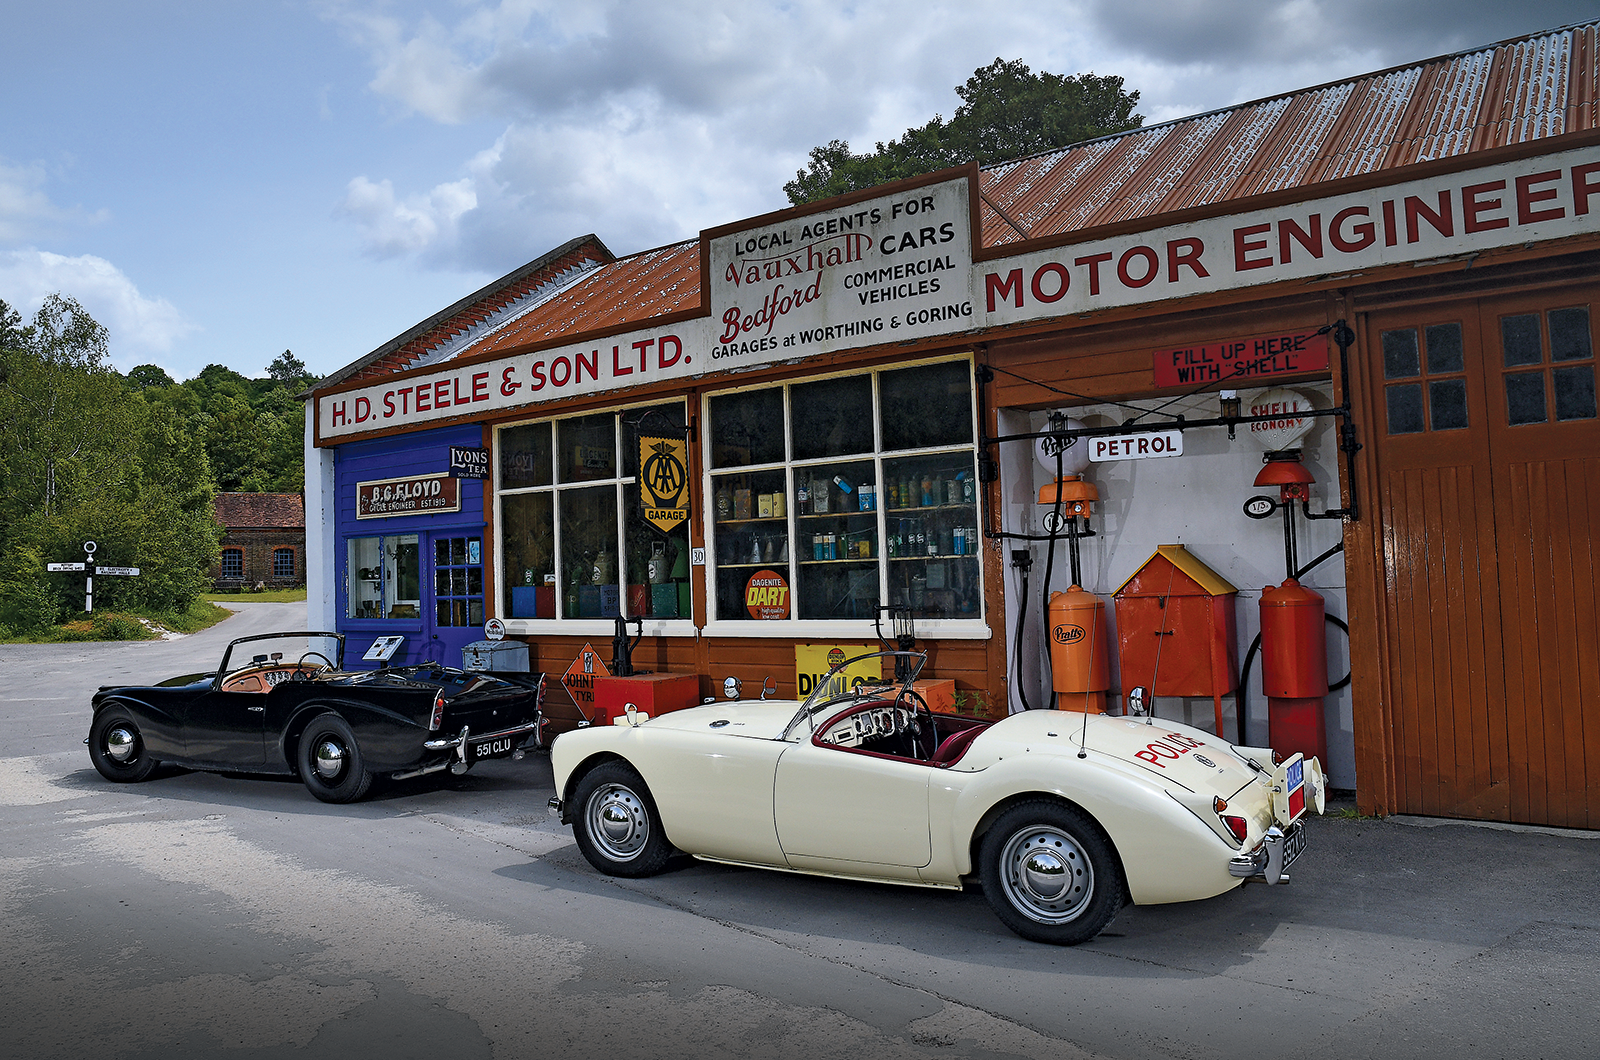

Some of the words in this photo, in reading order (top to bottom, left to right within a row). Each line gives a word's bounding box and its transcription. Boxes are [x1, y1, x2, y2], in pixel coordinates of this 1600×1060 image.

[735, 230, 793, 257] LOCAL
[800, 208, 882, 241] AGENTS
[891, 195, 936, 220] FOR
[725, 232, 874, 289] Vauxhall
[879, 222, 956, 256] CARS
[843, 254, 957, 290] COMMERCIAL
[983, 236, 1211, 314] MOTOR
[857, 277, 942, 306] VEHICLES
[719, 271, 824, 345] Bedford
[711, 336, 778, 360] GARAGES
[782, 332, 796, 348] at
[799, 317, 884, 345] WORTHING
[889, 315, 902, 329] &
[905, 301, 973, 326] GORING
[1172, 346, 1214, 367] FILL
[1221, 343, 1247, 361] UP
[1253, 335, 1307, 359] HERE
[331, 396, 377, 428] H.D.
[383, 371, 490, 419] STEELE
[499, 366, 523, 397] &
[530, 349, 600, 392] SON
[612, 334, 693, 378] LTD.
[1177, 362, 1221, 384] WITH
[1250, 417, 1304, 432] ECONOMY
[450, 448, 488, 468] LYONS
[1096, 435, 1177, 458] PETROL
[467, 464, 487, 474] TEA
[388, 500, 416, 511] ENGINEER
[648, 510, 685, 520] GARAGE
[746, 586, 789, 606] DART
[1054, 626, 1083, 642] Pratts
[564, 673, 590, 689] JOHN
[476, 743, 492, 757] 551
[492, 738, 511, 753] CLU
[1134, 732, 1206, 769] POLICE
